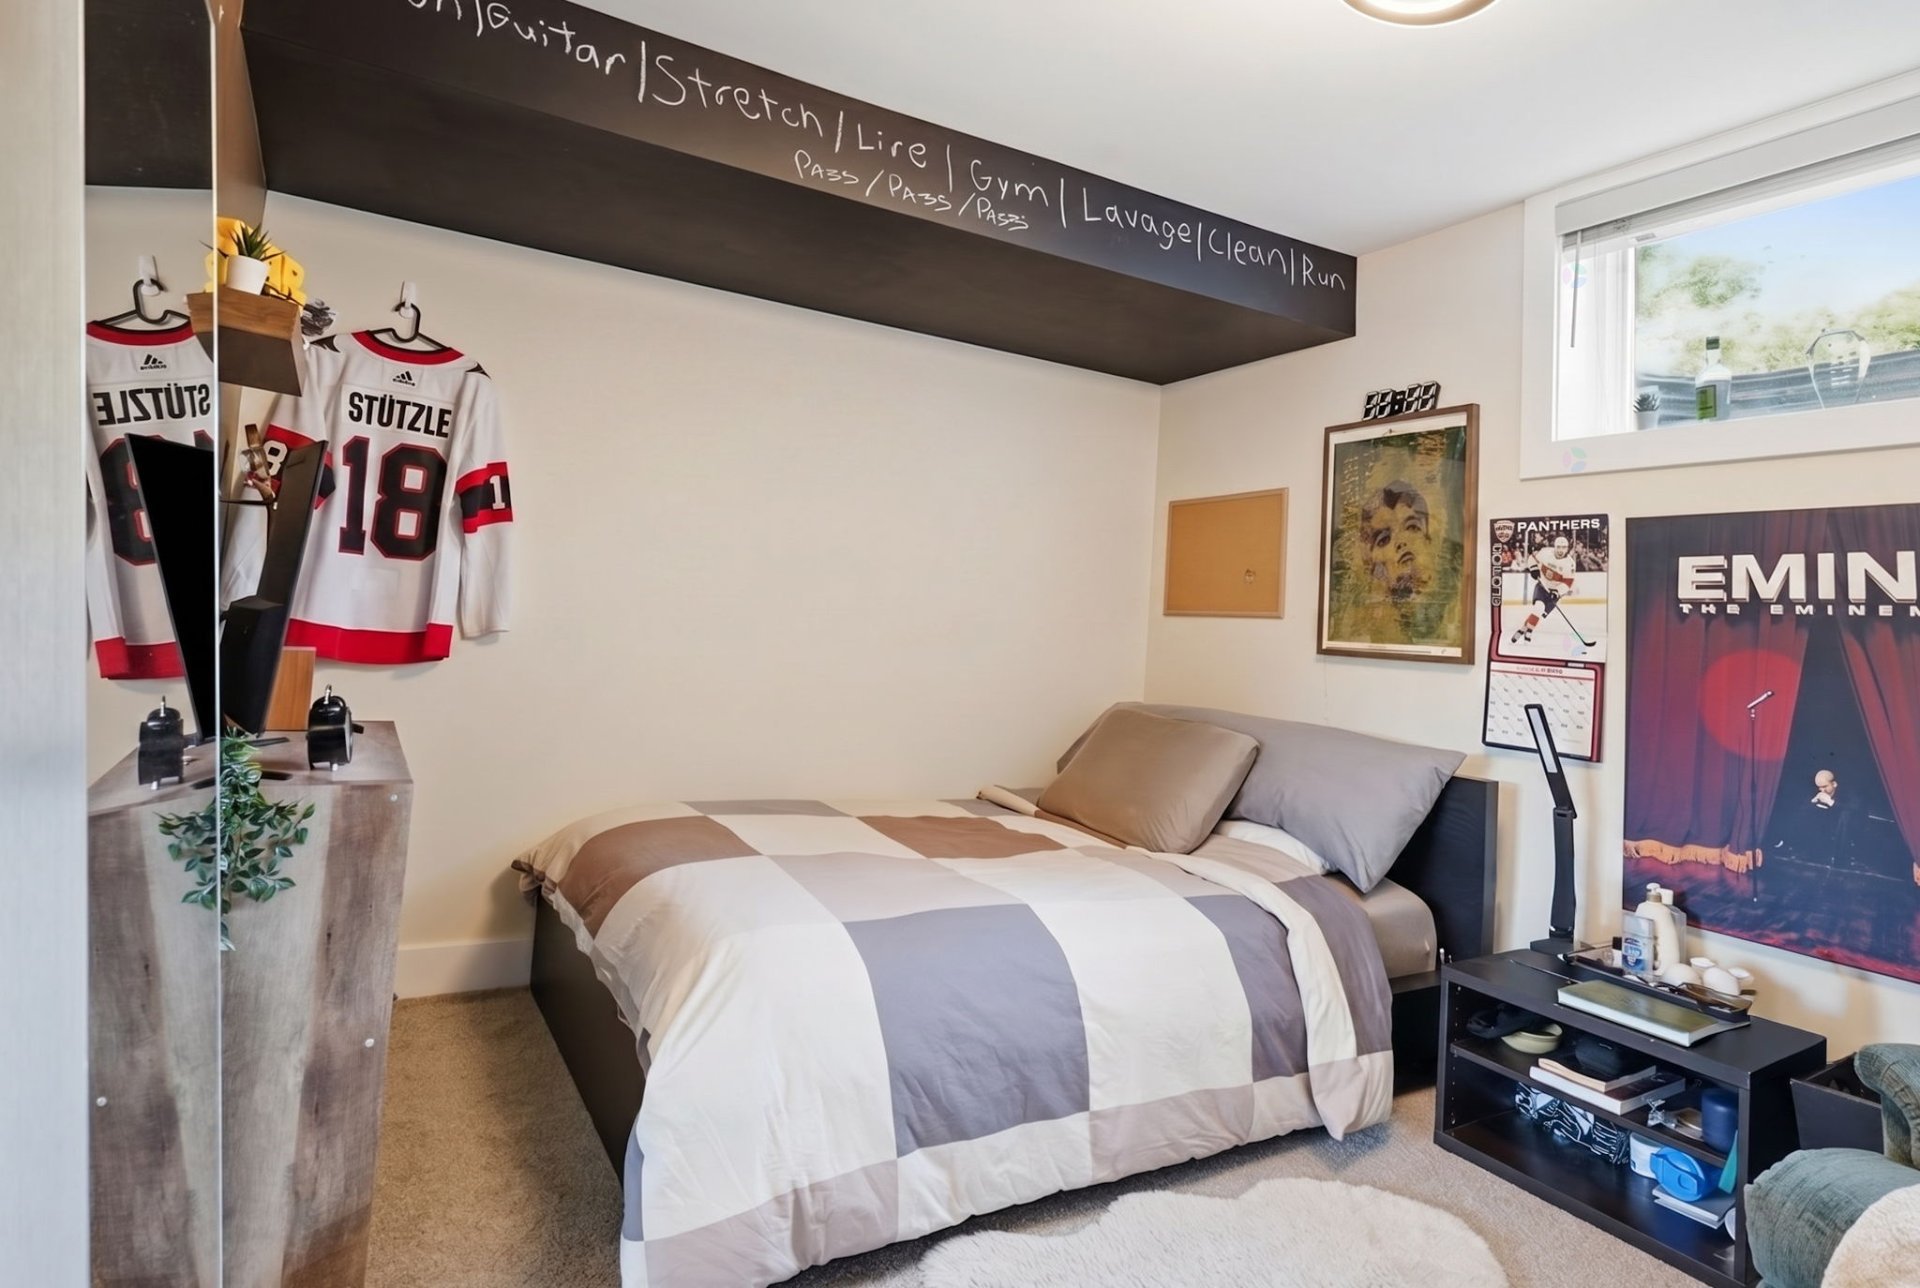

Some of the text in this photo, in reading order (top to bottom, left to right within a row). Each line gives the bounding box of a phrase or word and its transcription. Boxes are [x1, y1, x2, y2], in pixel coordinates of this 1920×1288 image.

[486, 2, 626, 75] Guitar
[651, 55, 823, 137] Stretch
[857, 123, 927, 169] Lire
[970, 159, 1049, 207] Gym
[1082, 187, 1192, 251] Lavage
[1208, 228, 1287, 275] Clean
[1302, 253, 1346, 291] Run
[348, 391, 453, 439] STÜTZLE
[338, 435, 447, 561] 18
[1517, 519, 1600, 532] PANTHERS
[1680, 604, 1740, 615] THE
